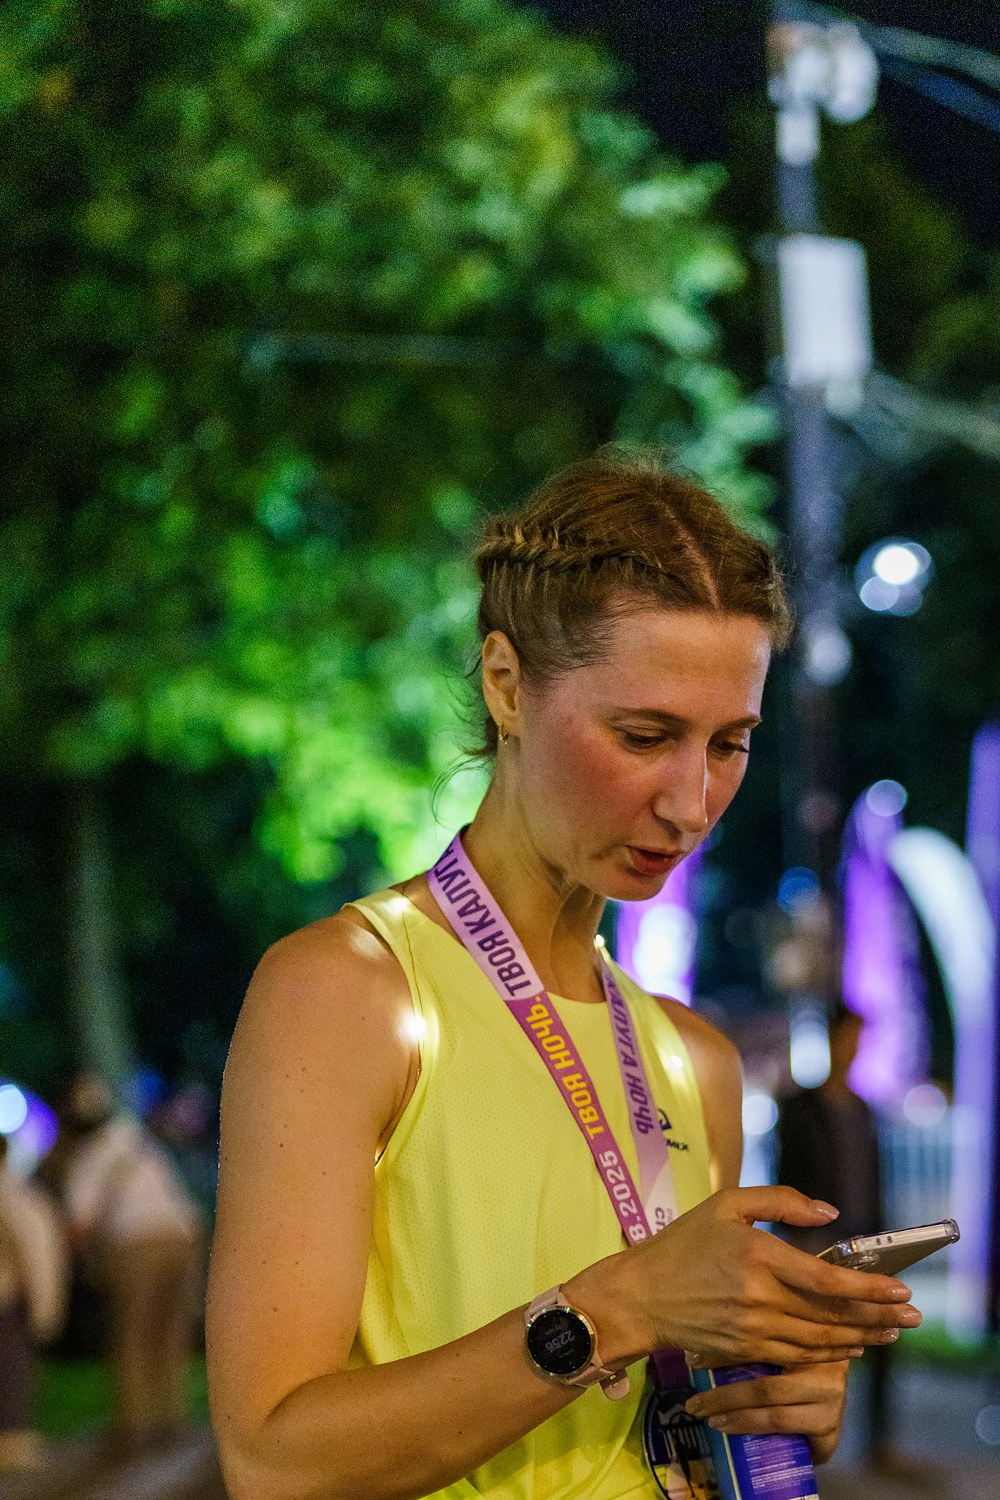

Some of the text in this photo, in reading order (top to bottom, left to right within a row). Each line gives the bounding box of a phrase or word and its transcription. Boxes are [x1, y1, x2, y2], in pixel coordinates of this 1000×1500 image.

[477, 930, 531, 997] ТВОЯ
[526, 995, 604, 1140] ТВОЯ НОЧЬ.
[625, 1073, 654, 1134] НОЧЬ
[599, 1150, 647, 1243] 8.2025
